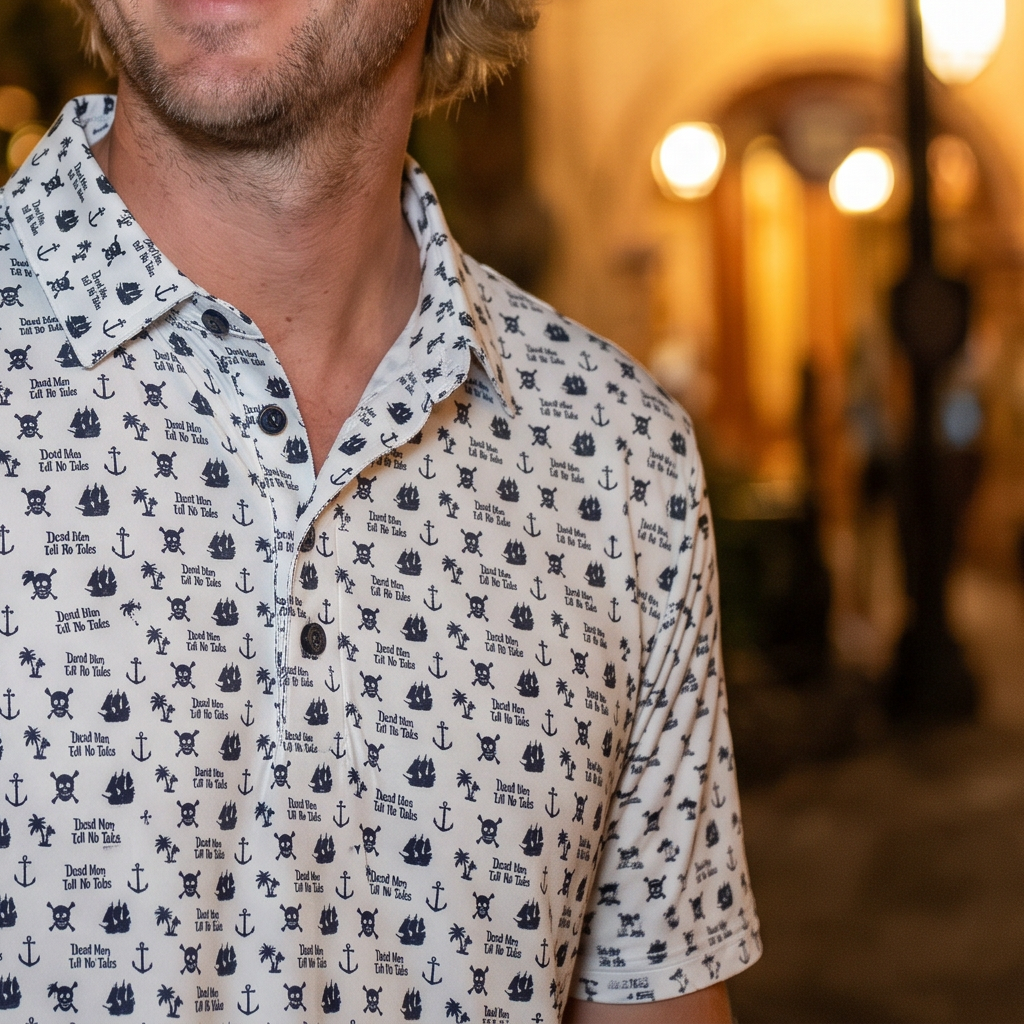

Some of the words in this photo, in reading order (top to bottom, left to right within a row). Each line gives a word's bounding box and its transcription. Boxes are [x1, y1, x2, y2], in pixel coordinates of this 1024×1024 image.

[55, 460, 68, 473] No
[72, 620, 86, 633] No
[387, 655, 398, 667] No
[84, 744, 96, 757] No
[507, 794, 518, 807] No
[87, 831, 100, 844] No
[79, 877, 91, 890] No
[69, 942, 93, 956] Dead
[83, 956, 96, 969] No
